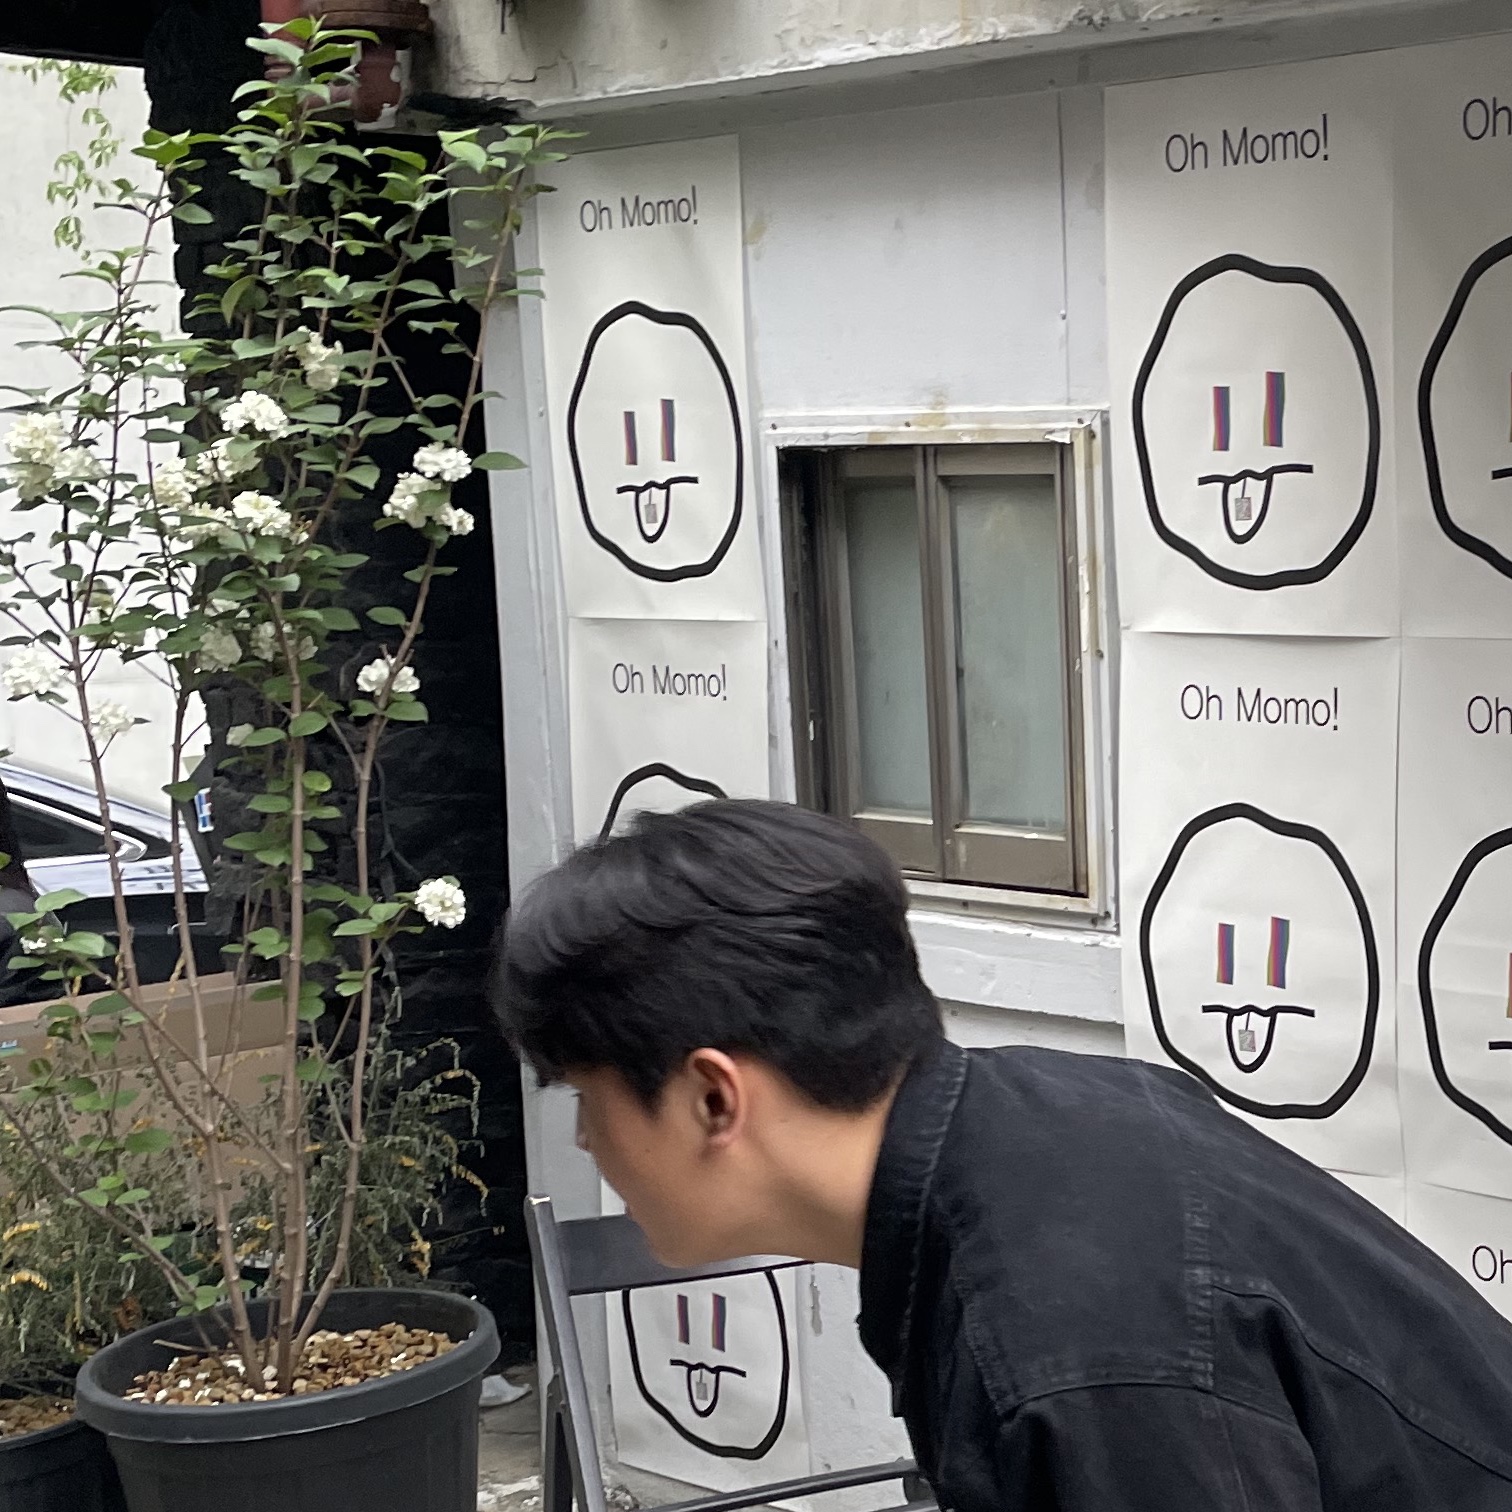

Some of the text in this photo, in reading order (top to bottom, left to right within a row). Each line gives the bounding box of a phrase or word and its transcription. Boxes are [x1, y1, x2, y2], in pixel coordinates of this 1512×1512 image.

[1462, 96, 1512, 141] Oh
[1165, 113, 1329, 173] Oh Momo!
[579, 185, 698, 233] Oh Momo!
[612, 662, 728, 702] Oh Momo!
[1180, 683, 1339, 732] Oh Momo!
